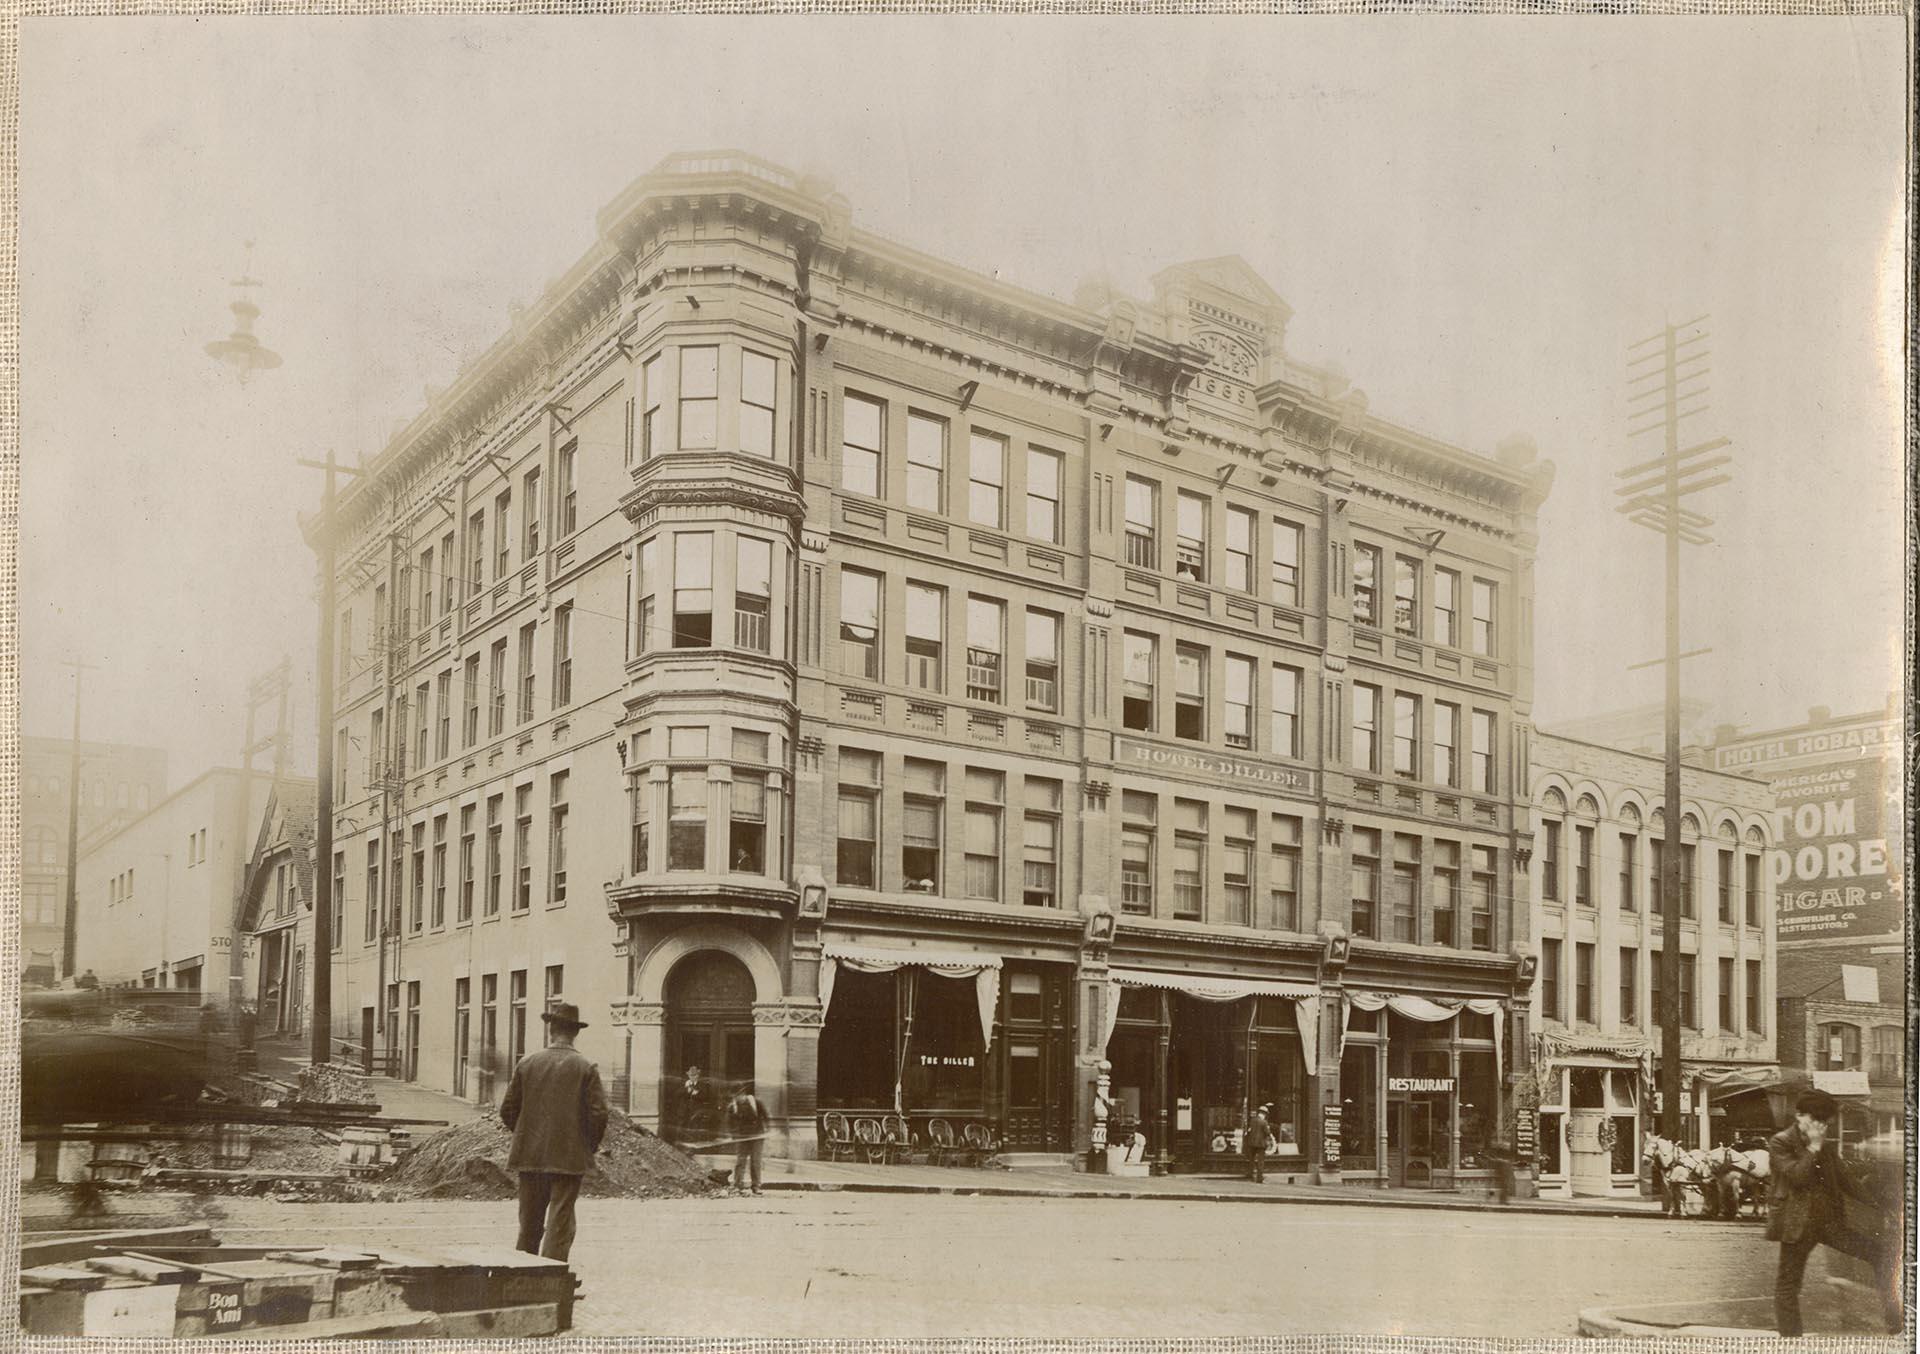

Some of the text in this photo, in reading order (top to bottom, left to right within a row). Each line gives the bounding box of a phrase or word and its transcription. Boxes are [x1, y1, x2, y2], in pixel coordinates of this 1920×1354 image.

[1725, 742, 1789, 766] HOTEL
[1136, 747, 1302, 786] HOTEL DILLER
[1775, 798, 1856, 842] TOM
[1776, 838, 1888, 884] OORE
[1776, 887, 1866, 912] IGAR
[1779, 921, 1849, 933] DISTRIBUTORS
[920, 1055, 938, 1066] THE
[1389, 1078, 1455, 1091] RESTAURANT
[208, 1293, 239, 1309] Bon
[212, 1306, 242, 1324] Ami
